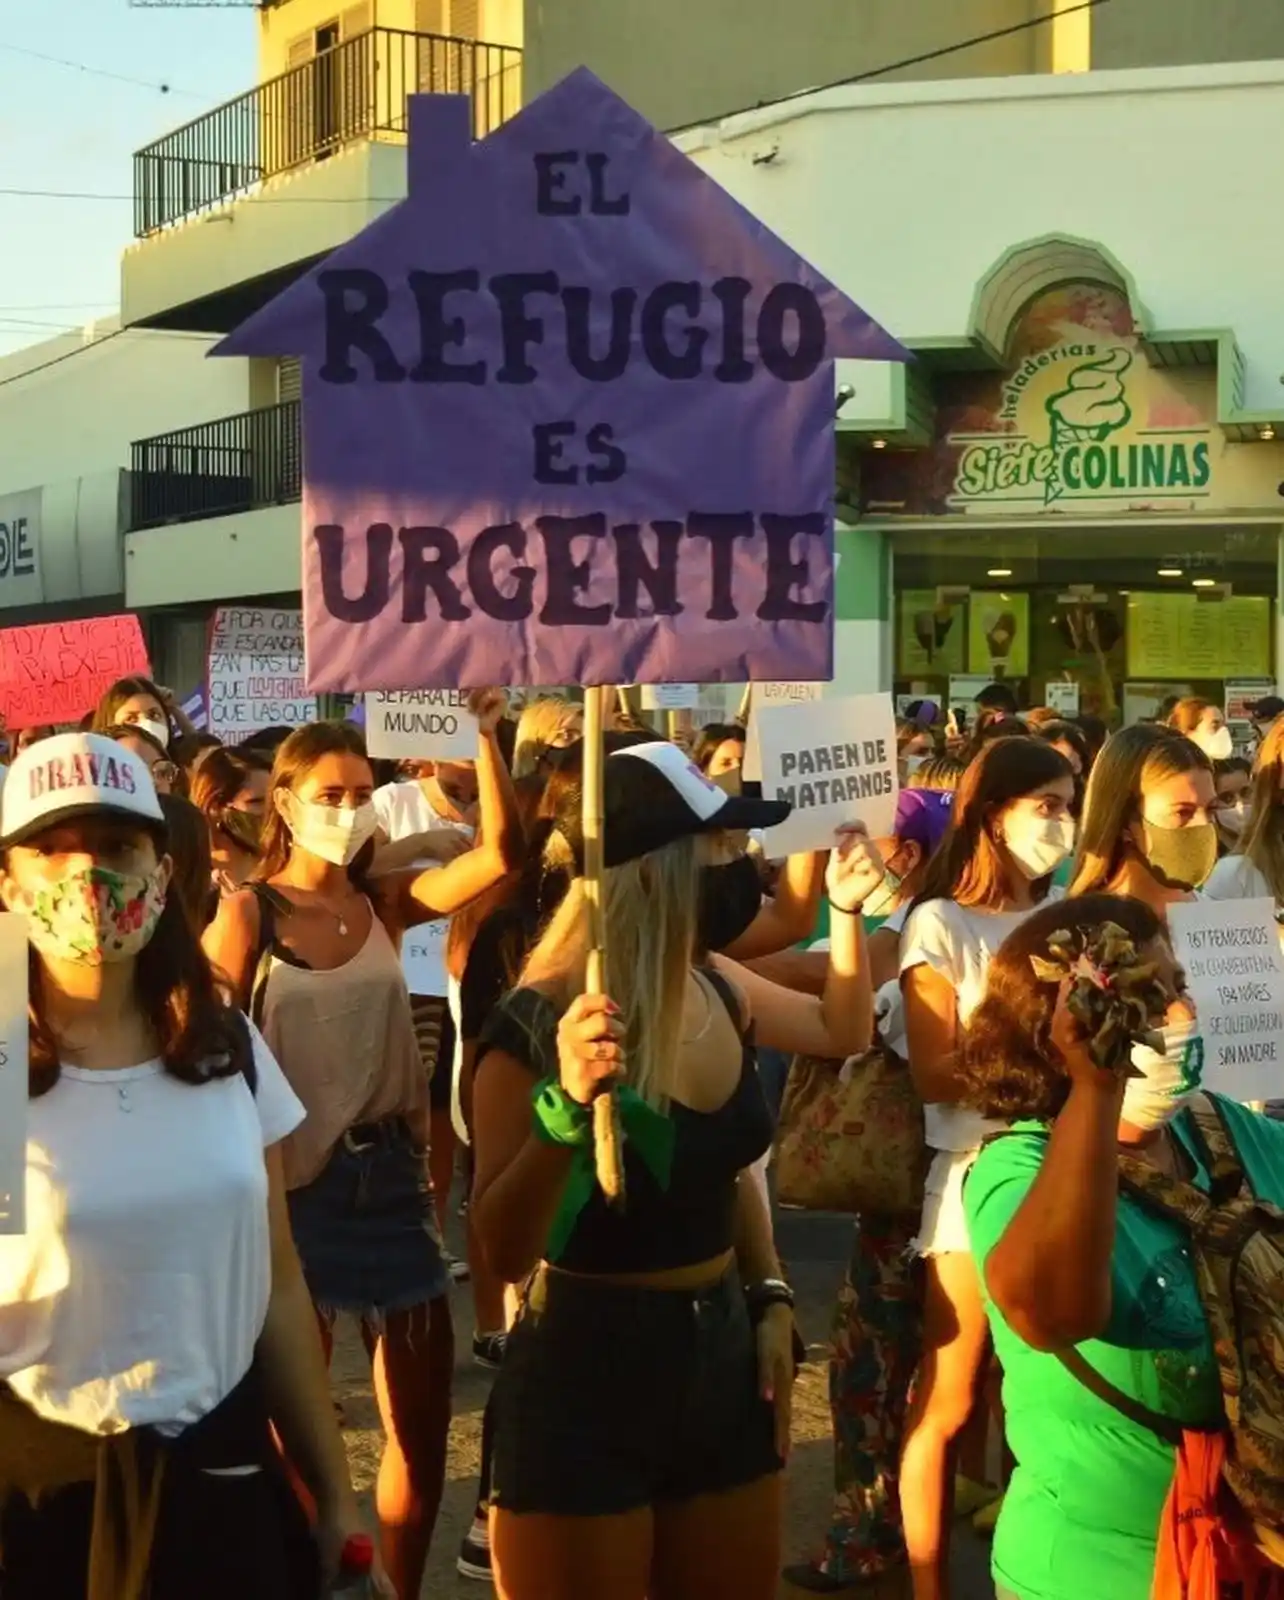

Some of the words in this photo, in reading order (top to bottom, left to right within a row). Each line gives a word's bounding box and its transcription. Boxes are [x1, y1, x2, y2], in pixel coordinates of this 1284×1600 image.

[533, 151, 630, 217] EL
[317, 269, 827, 386] REFUGIO
[1000, 344, 1096, 418] heladerias
[533, 421, 627, 486] ES
[958, 444, 1057, 496] Siete
[1062, 442, 1211, 490] COLINAS
[314, 512, 829, 627] URGENTE
[211, 681, 245, 702] QUE
[211, 703, 246, 723] QUE
[252, 702, 281, 721] LAS
[384, 711, 458, 735] MUNDO
[29, 752, 136, 800] BRAVAS
[780, 742, 860, 778] PAREN
[864, 739, 887, 764] DE
[775, 769, 893, 811] MATARNOS
[1217, 1045, 1236, 1066] SIN
[1237, 1042, 1278, 1065] MADRE
